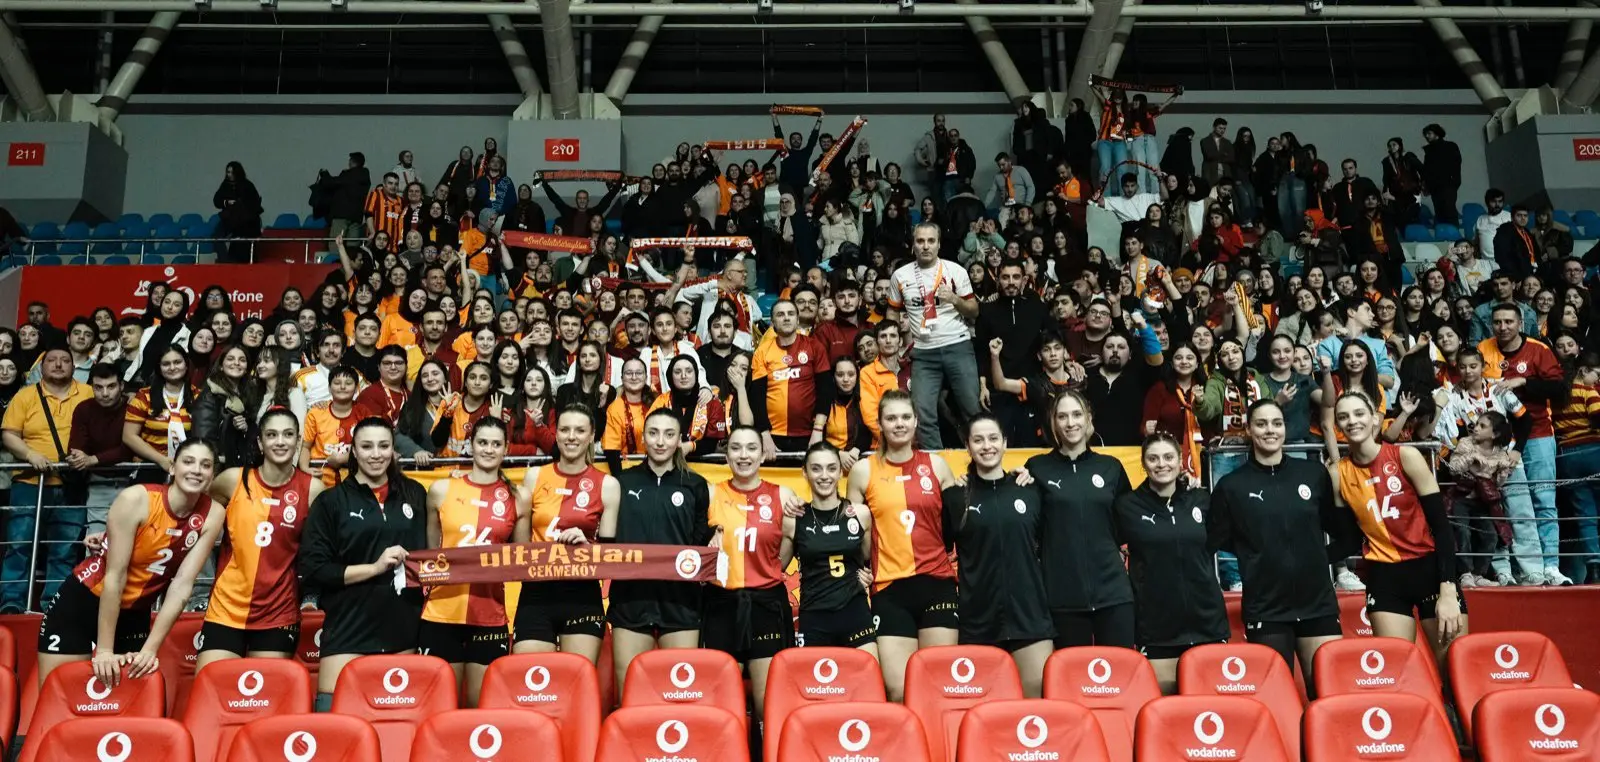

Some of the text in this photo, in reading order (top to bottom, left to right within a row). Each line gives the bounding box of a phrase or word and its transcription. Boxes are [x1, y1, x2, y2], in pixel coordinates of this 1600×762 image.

[16, 149, 37, 160] 211
[1579, 144, 1600, 155] 209
[632, 236, 734, 248] GALATASARAY
[1366, 493, 1400, 523] 14
[900, 509, 916, 535] 9
[254, 521, 274, 547] 8
[544, 516, 562, 541] 4
[458, 525, 493, 548] 24
[734, 526, 758, 552] 11
[146, 548, 174, 576] 2
[829, 555, 846, 578] 5
[527, 563, 598, 578] ÇEKMEKÖY
[873, 615, 881, 631] 9
[47, 634, 61, 652] 2
[1355, 676, 1395, 686] vodafone
[1490, 670, 1529, 680] vodafone
[805, 685, 846, 695] vodafone
[943, 684, 983, 695] vodafone
[1081, 685, 1120, 695] vodafone
[1216, 682, 1256, 692] vodafone
[374, 694, 416, 705] vodafone
[517, 692, 558, 703] vodafone
[663, 689, 703, 700] vodafone
[76, 701, 119, 712] vodafone
[228, 697, 270, 708] vodafone
[1356, 742, 1405, 754] vodafone
[1529, 737, 1578, 750] vodafone
[1008, 750, 1059, 762] vodafone
[1186, 746, 1236, 758] vodafone
